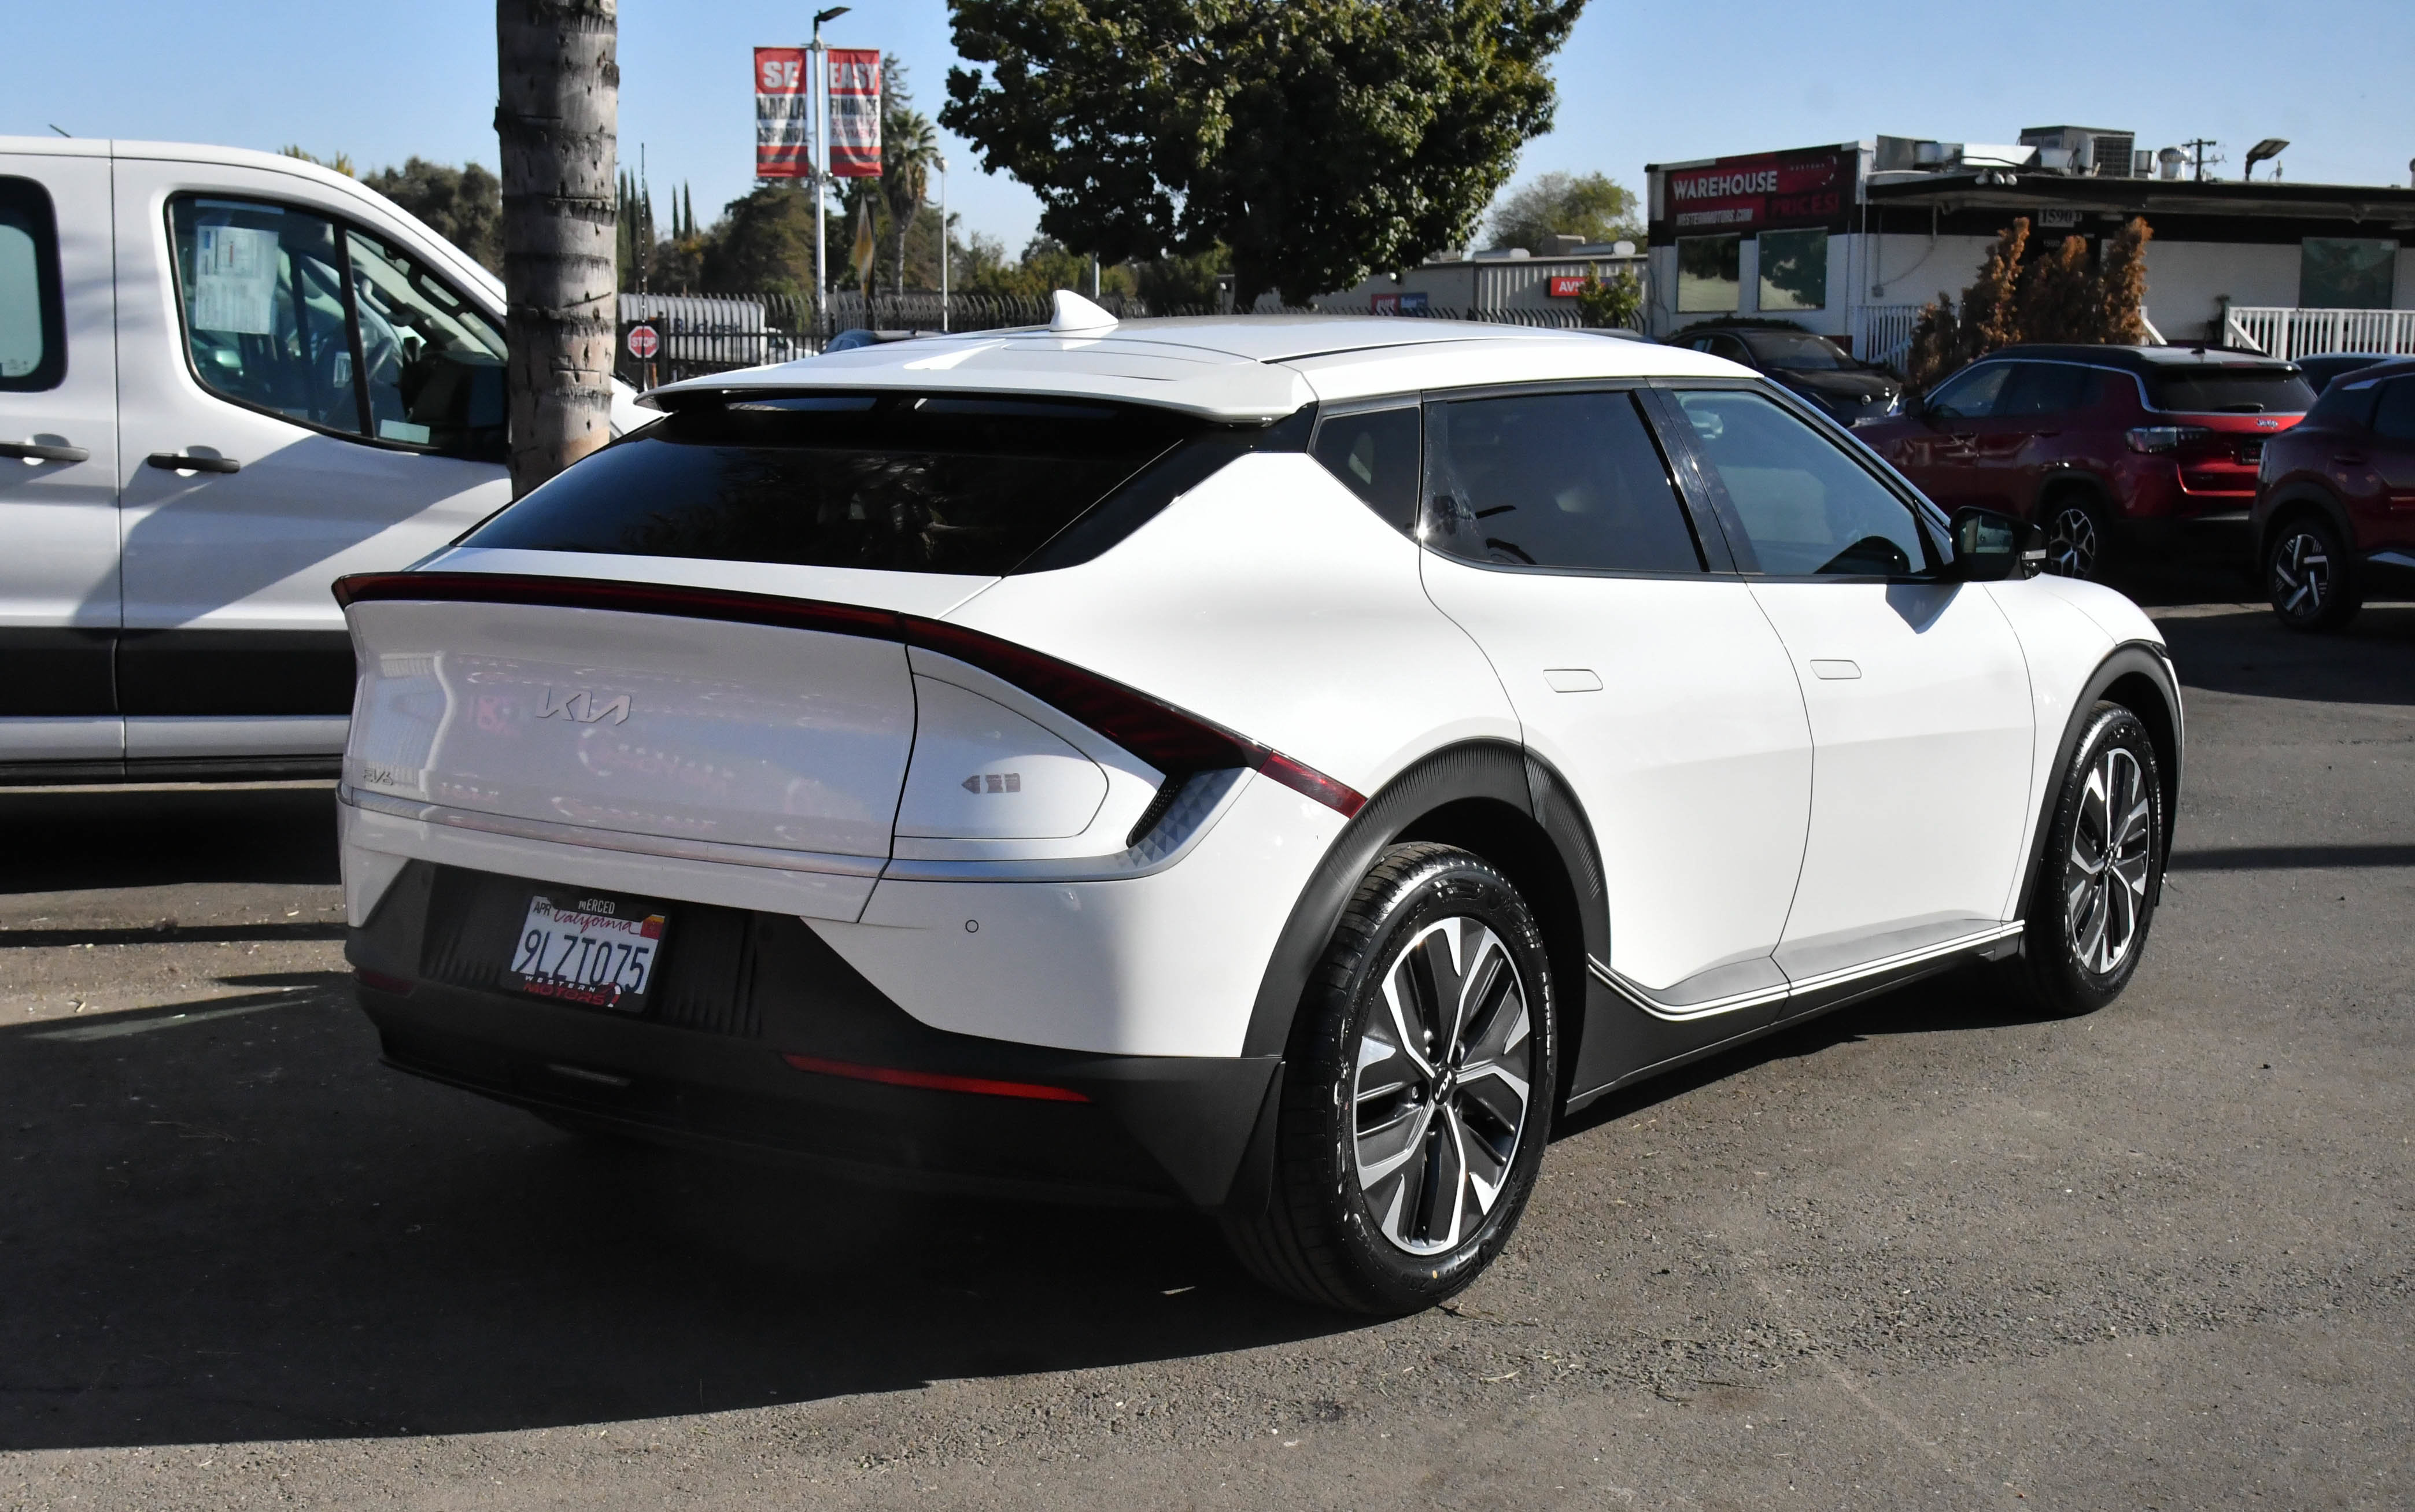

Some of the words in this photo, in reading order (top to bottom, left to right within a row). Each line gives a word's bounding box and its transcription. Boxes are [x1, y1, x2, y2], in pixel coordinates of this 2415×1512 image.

[763, 61, 799, 88] SE
[829, 62, 878, 89] EASY
[1672, 171, 1778, 201] WAREHOUSE
[631, 337, 657, 348] STOP
[363, 768, 394, 786] EV6
[533, 901, 552, 916] APR
[553, 909, 641, 935] California
[516, 929, 650, 993] 9LZT075
[523, 983, 606, 1007] MOTORS
[525, 975, 597, 993] WESTERN
